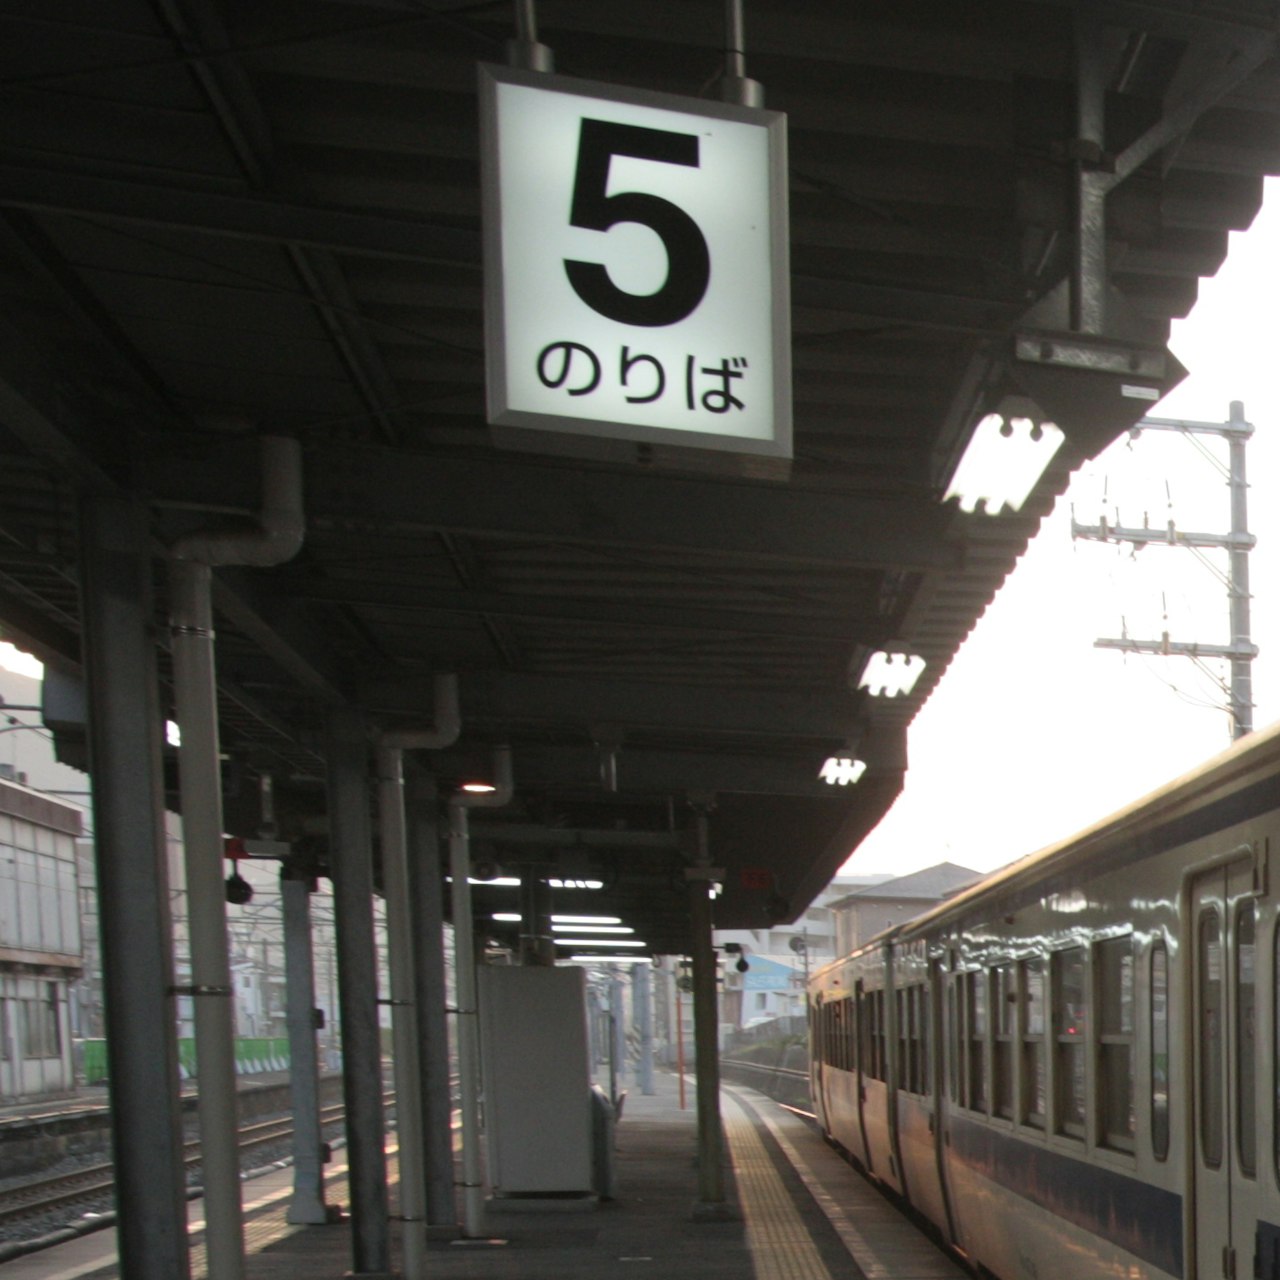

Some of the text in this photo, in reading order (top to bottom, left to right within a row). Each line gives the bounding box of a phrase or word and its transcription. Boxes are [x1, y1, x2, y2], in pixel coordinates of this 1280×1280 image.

[562, 117, 711, 328] 5
[536, 340, 749, 415] のりば
